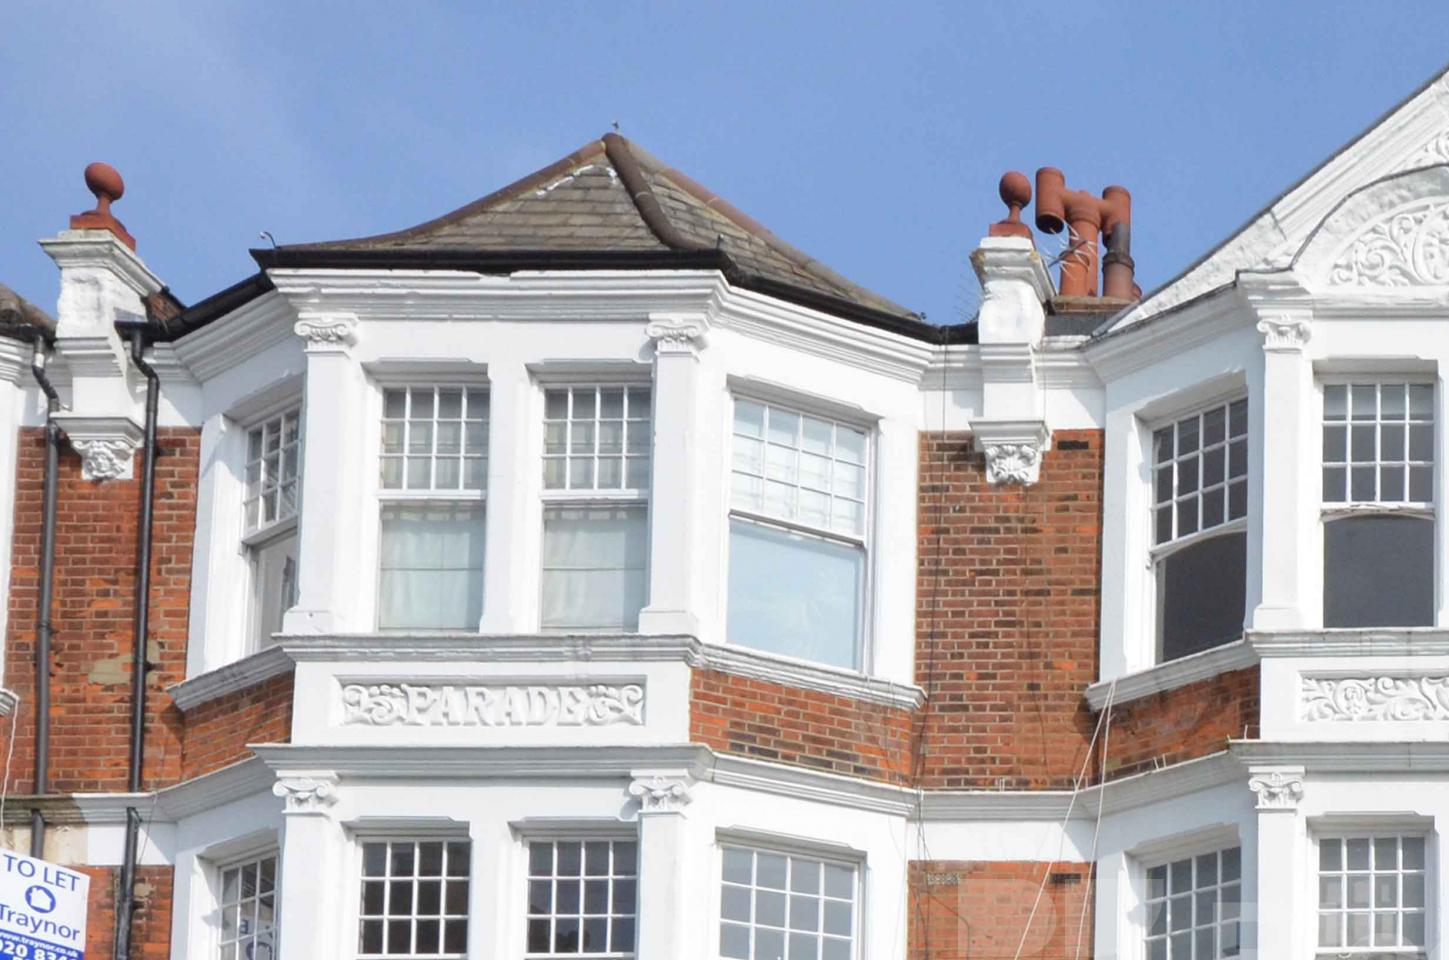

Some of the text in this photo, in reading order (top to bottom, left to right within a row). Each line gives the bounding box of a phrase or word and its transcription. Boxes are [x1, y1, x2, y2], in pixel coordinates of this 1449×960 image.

[404, 685, 585, 726] PARADE
[3, 854, 80, 892] TO LET
[0, 903, 80, 942] Traynor
[0, 940, 28, 957] 20
